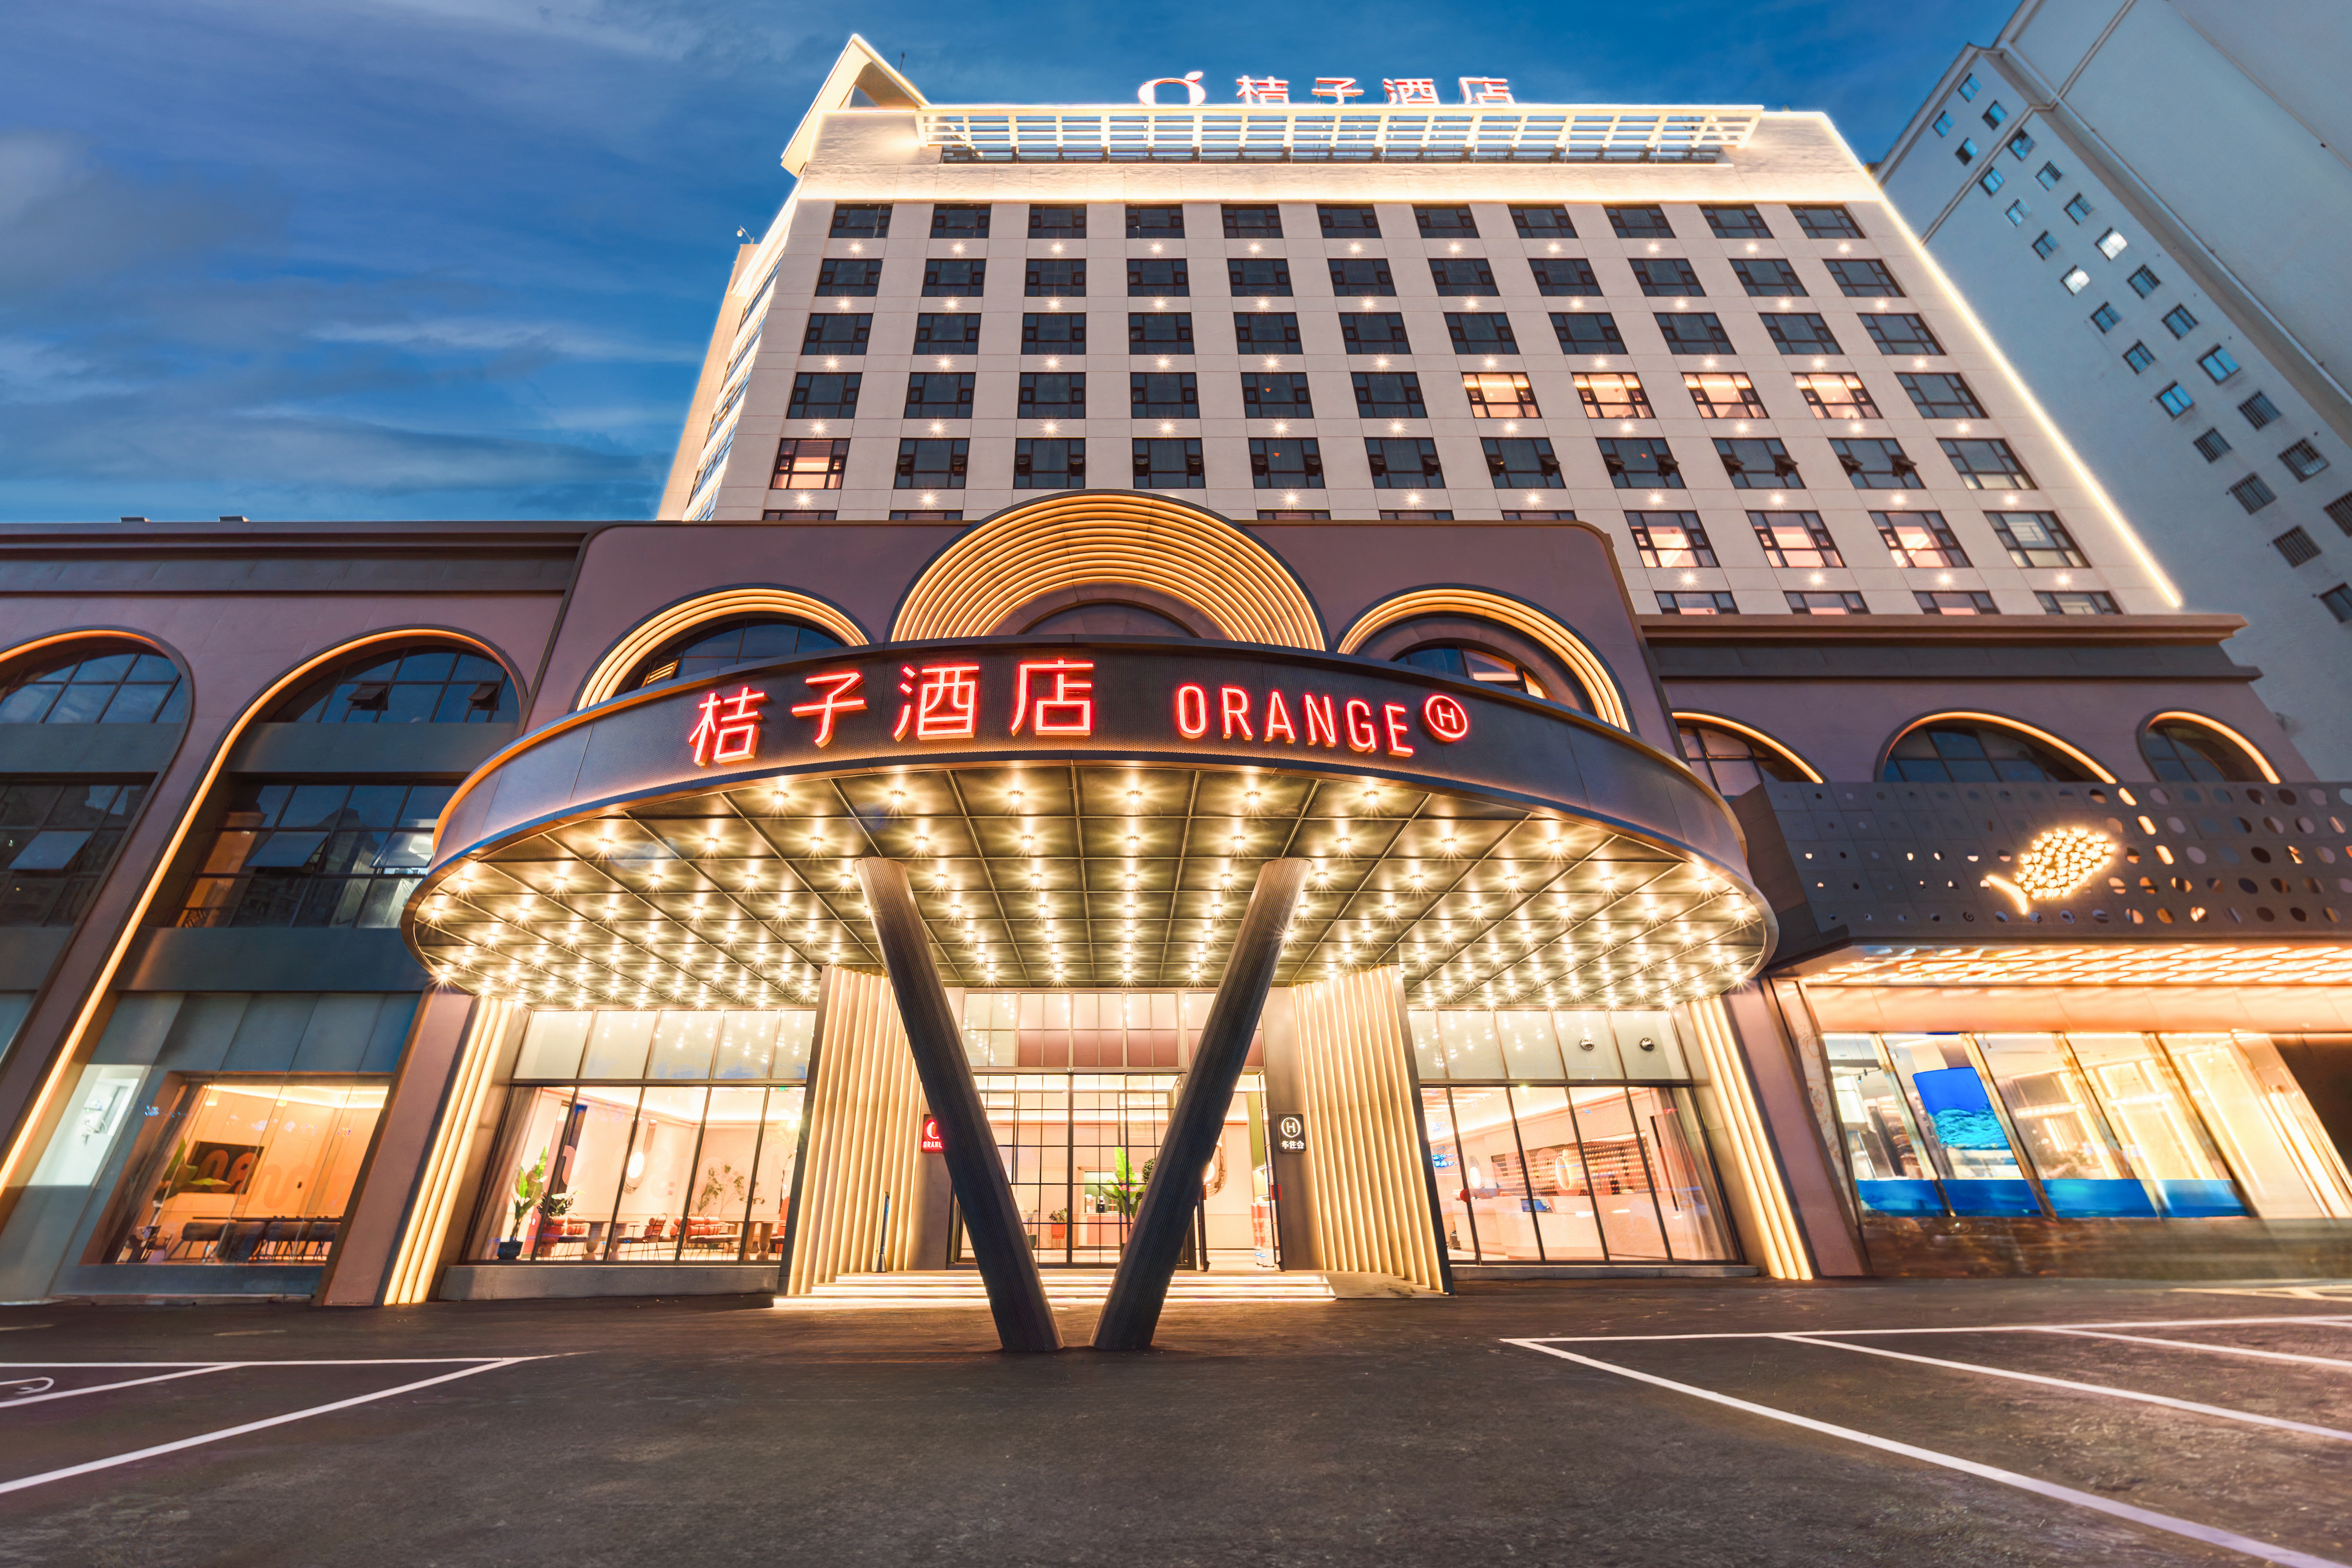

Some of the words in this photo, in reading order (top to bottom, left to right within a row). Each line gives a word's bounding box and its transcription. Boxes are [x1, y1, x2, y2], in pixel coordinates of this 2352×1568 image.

[1236, 75, 1515, 105] 桔子酒店
[688, 660, 1094, 766] 桔子酒店
[1177, 685, 1414, 757] ORANGE
[1281, 1140, 1304, 1149] 华住会
